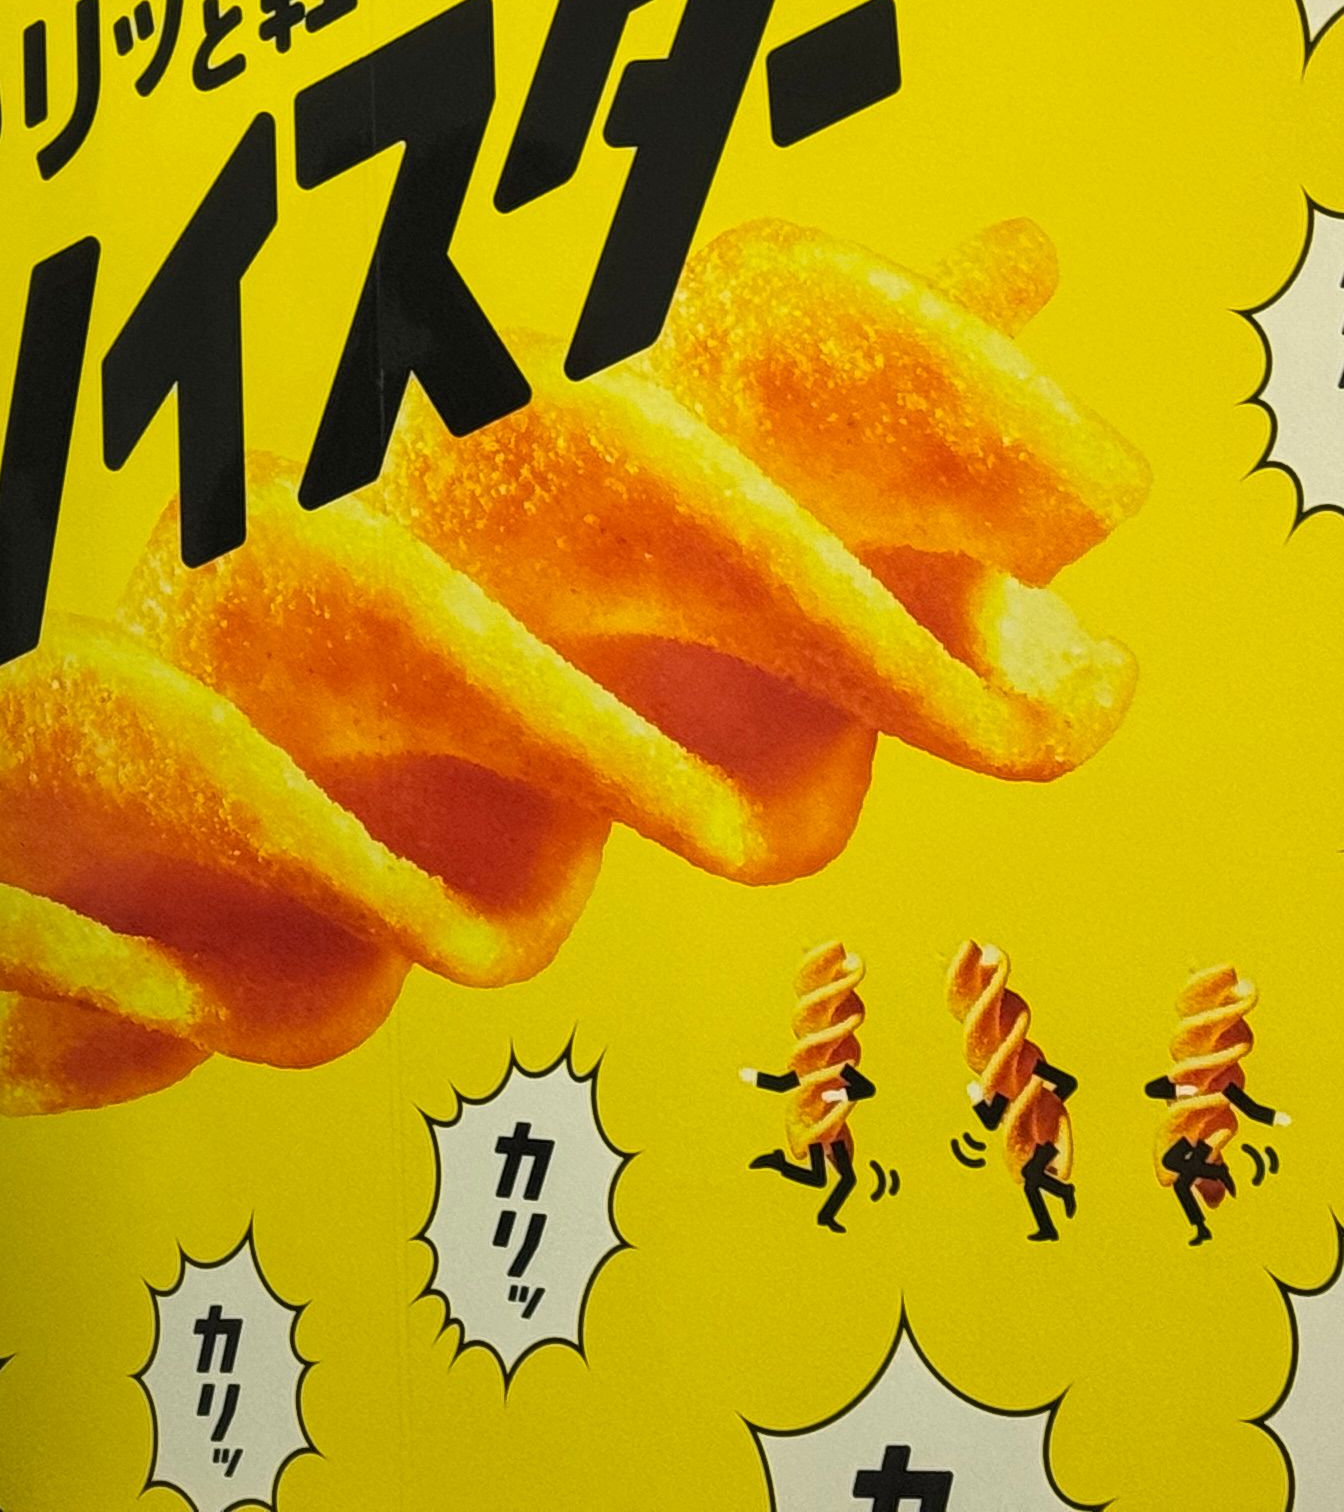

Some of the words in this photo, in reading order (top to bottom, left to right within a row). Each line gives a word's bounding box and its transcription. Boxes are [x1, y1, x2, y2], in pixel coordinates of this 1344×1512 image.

[492, 1122, 555, 1319] カリッ
[193, 1305, 243, 1478] カリッ
